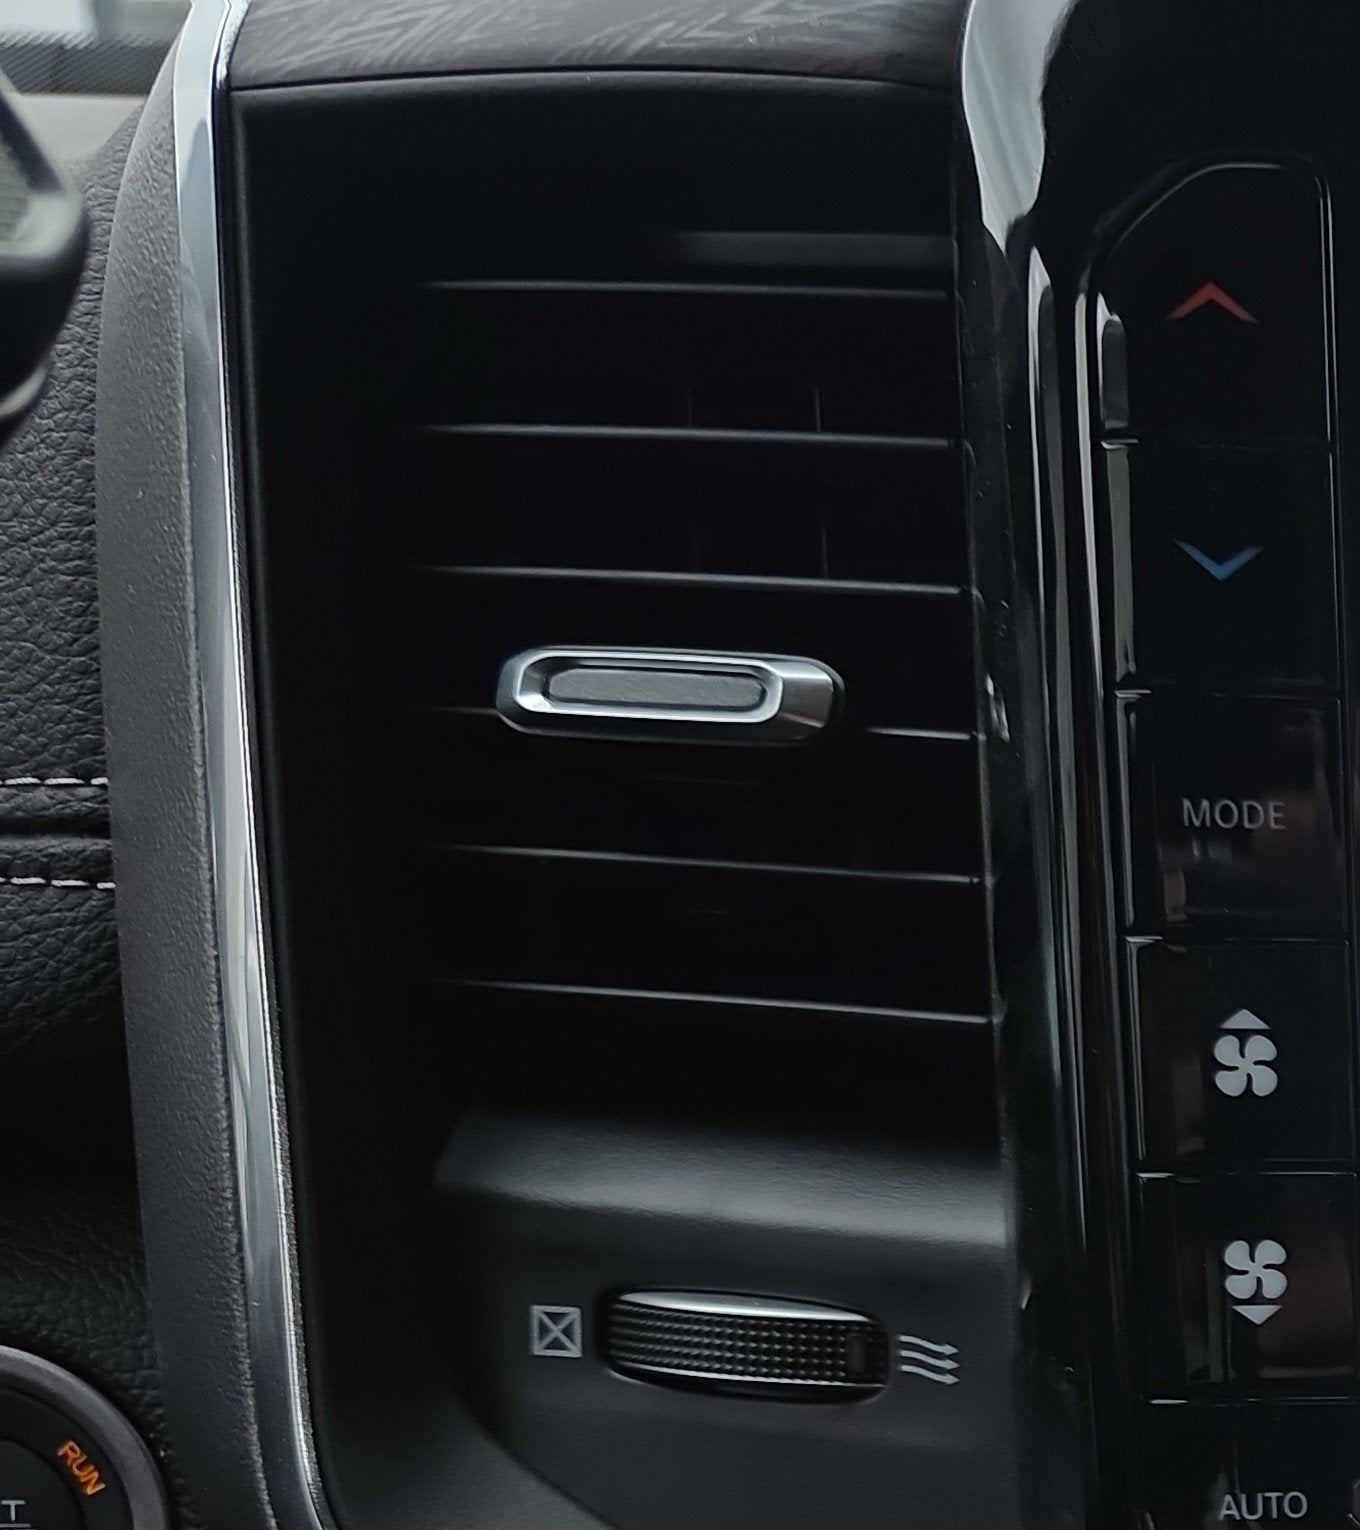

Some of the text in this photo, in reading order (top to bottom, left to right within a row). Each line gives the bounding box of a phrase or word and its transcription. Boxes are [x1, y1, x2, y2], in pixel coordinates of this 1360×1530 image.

[1181, 797, 1289, 832] MODE
[57, 1439, 106, 1497] RUN
[1216, 1490, 1309, 1522] AUTO
